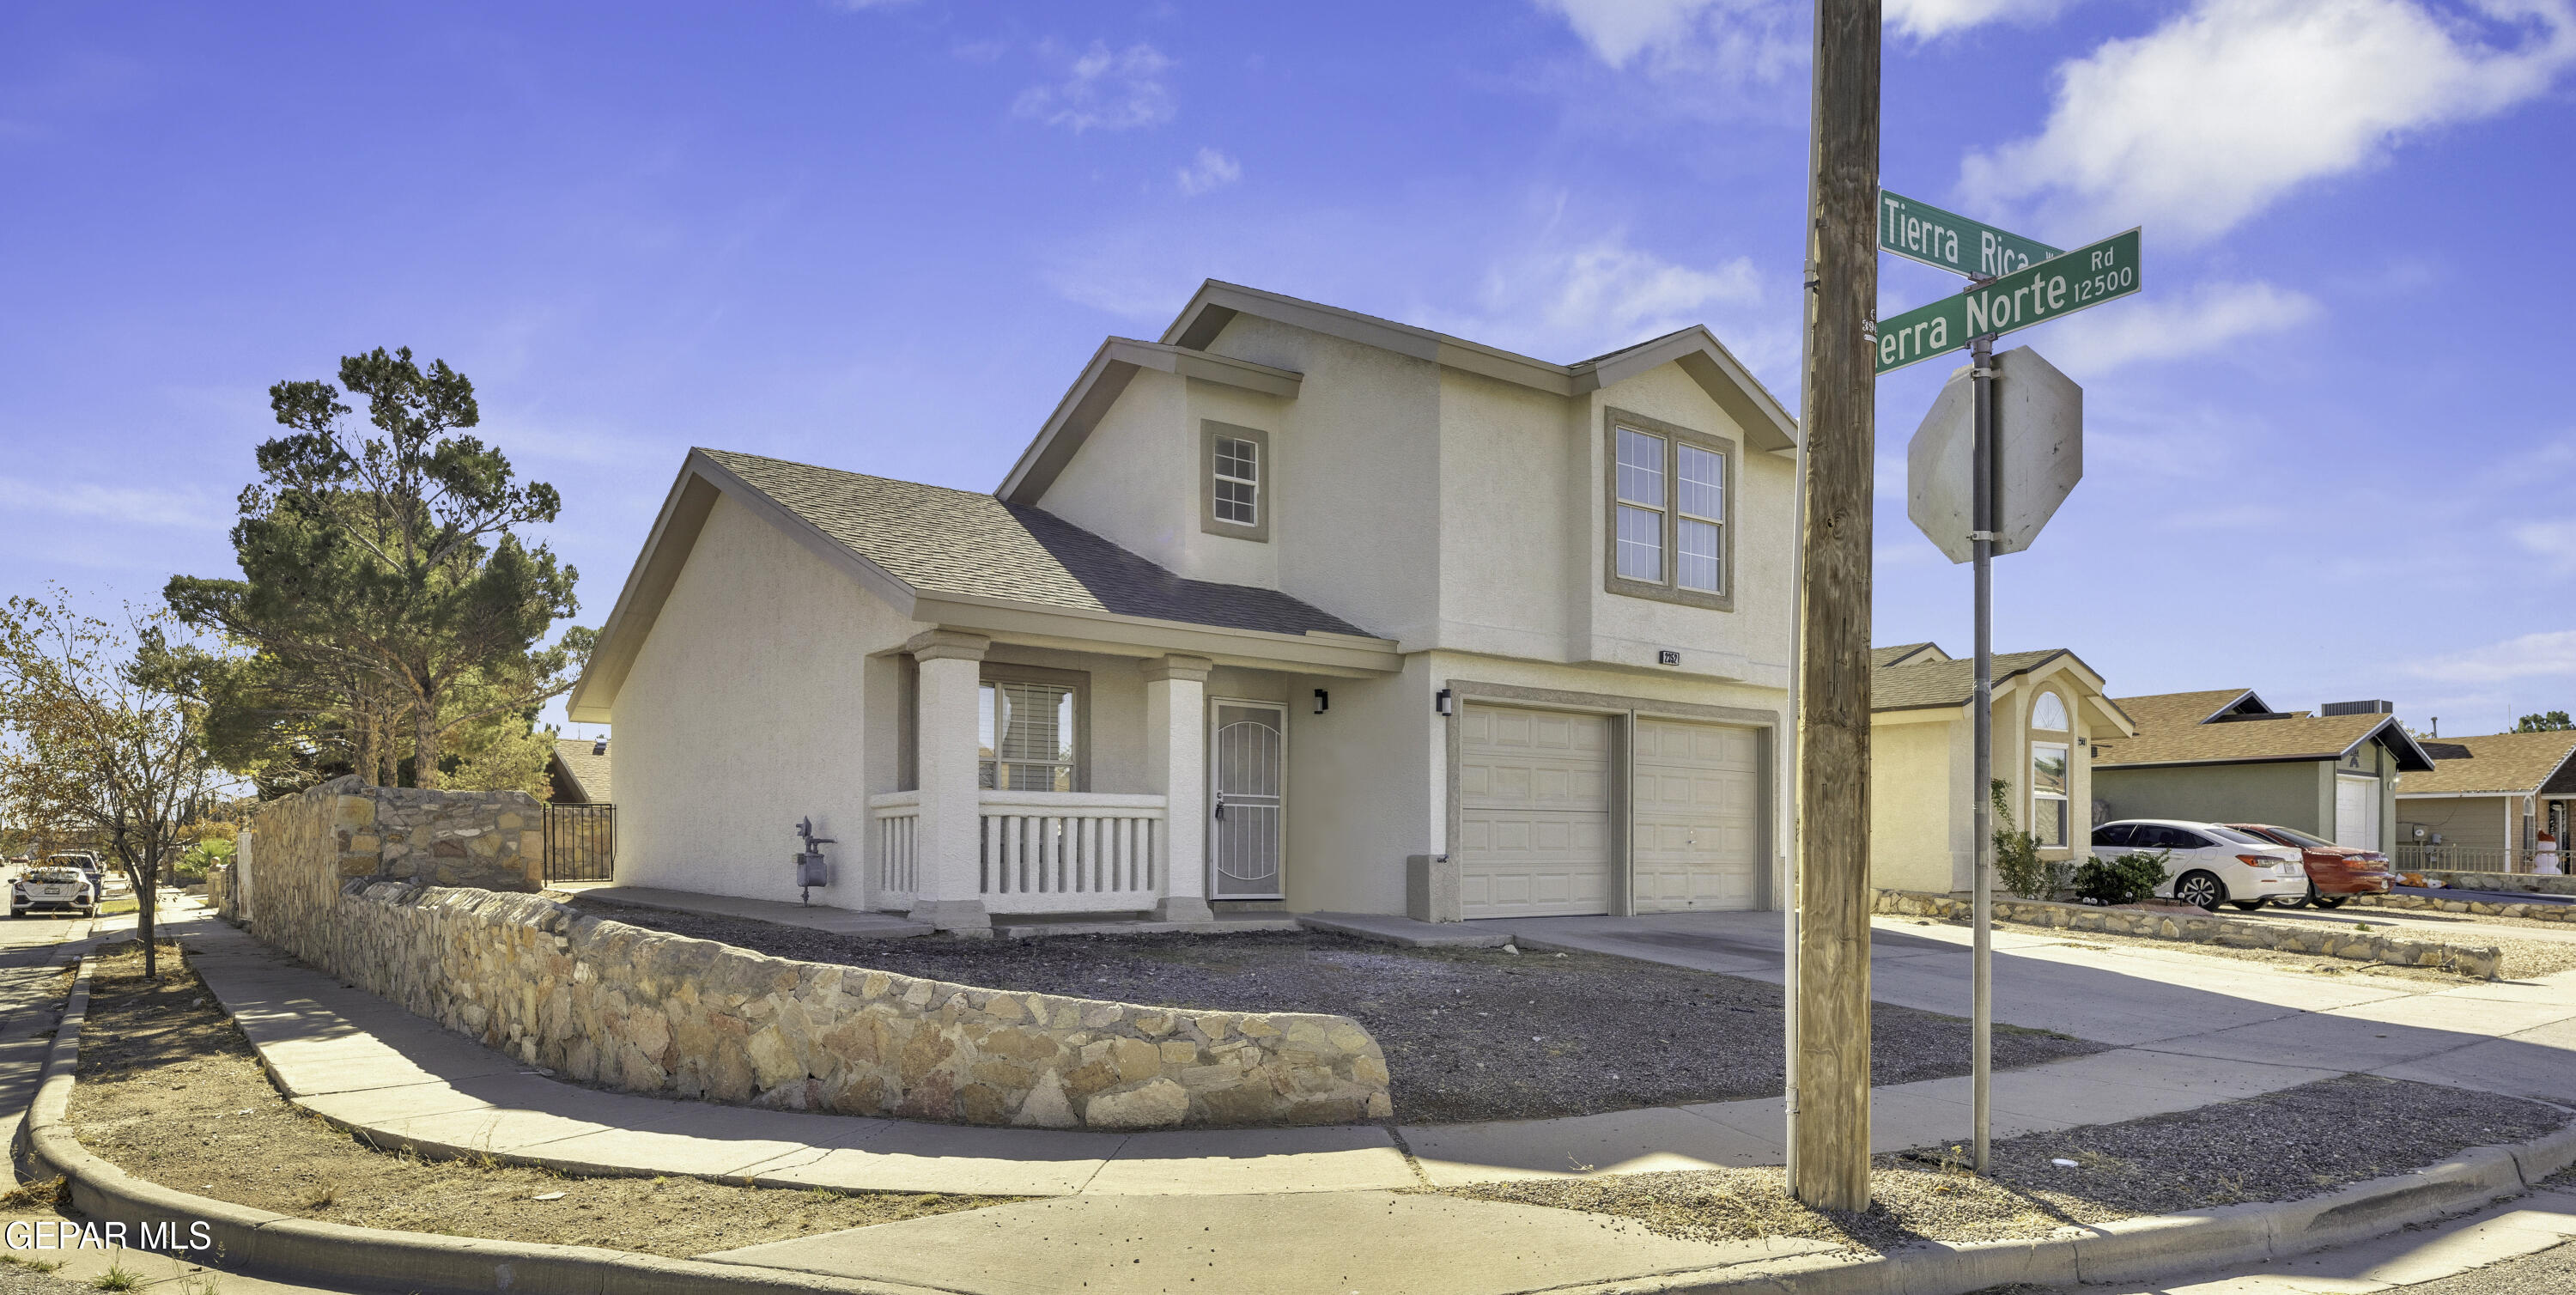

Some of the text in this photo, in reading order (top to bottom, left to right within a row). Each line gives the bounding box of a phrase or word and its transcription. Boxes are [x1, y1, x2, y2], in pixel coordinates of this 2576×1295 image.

[1885, 198, 1958, 264] Tierra
[1875, 246, 2114, 368] erra Norte Rd
[2074, 266, 2132, 303] 12500
